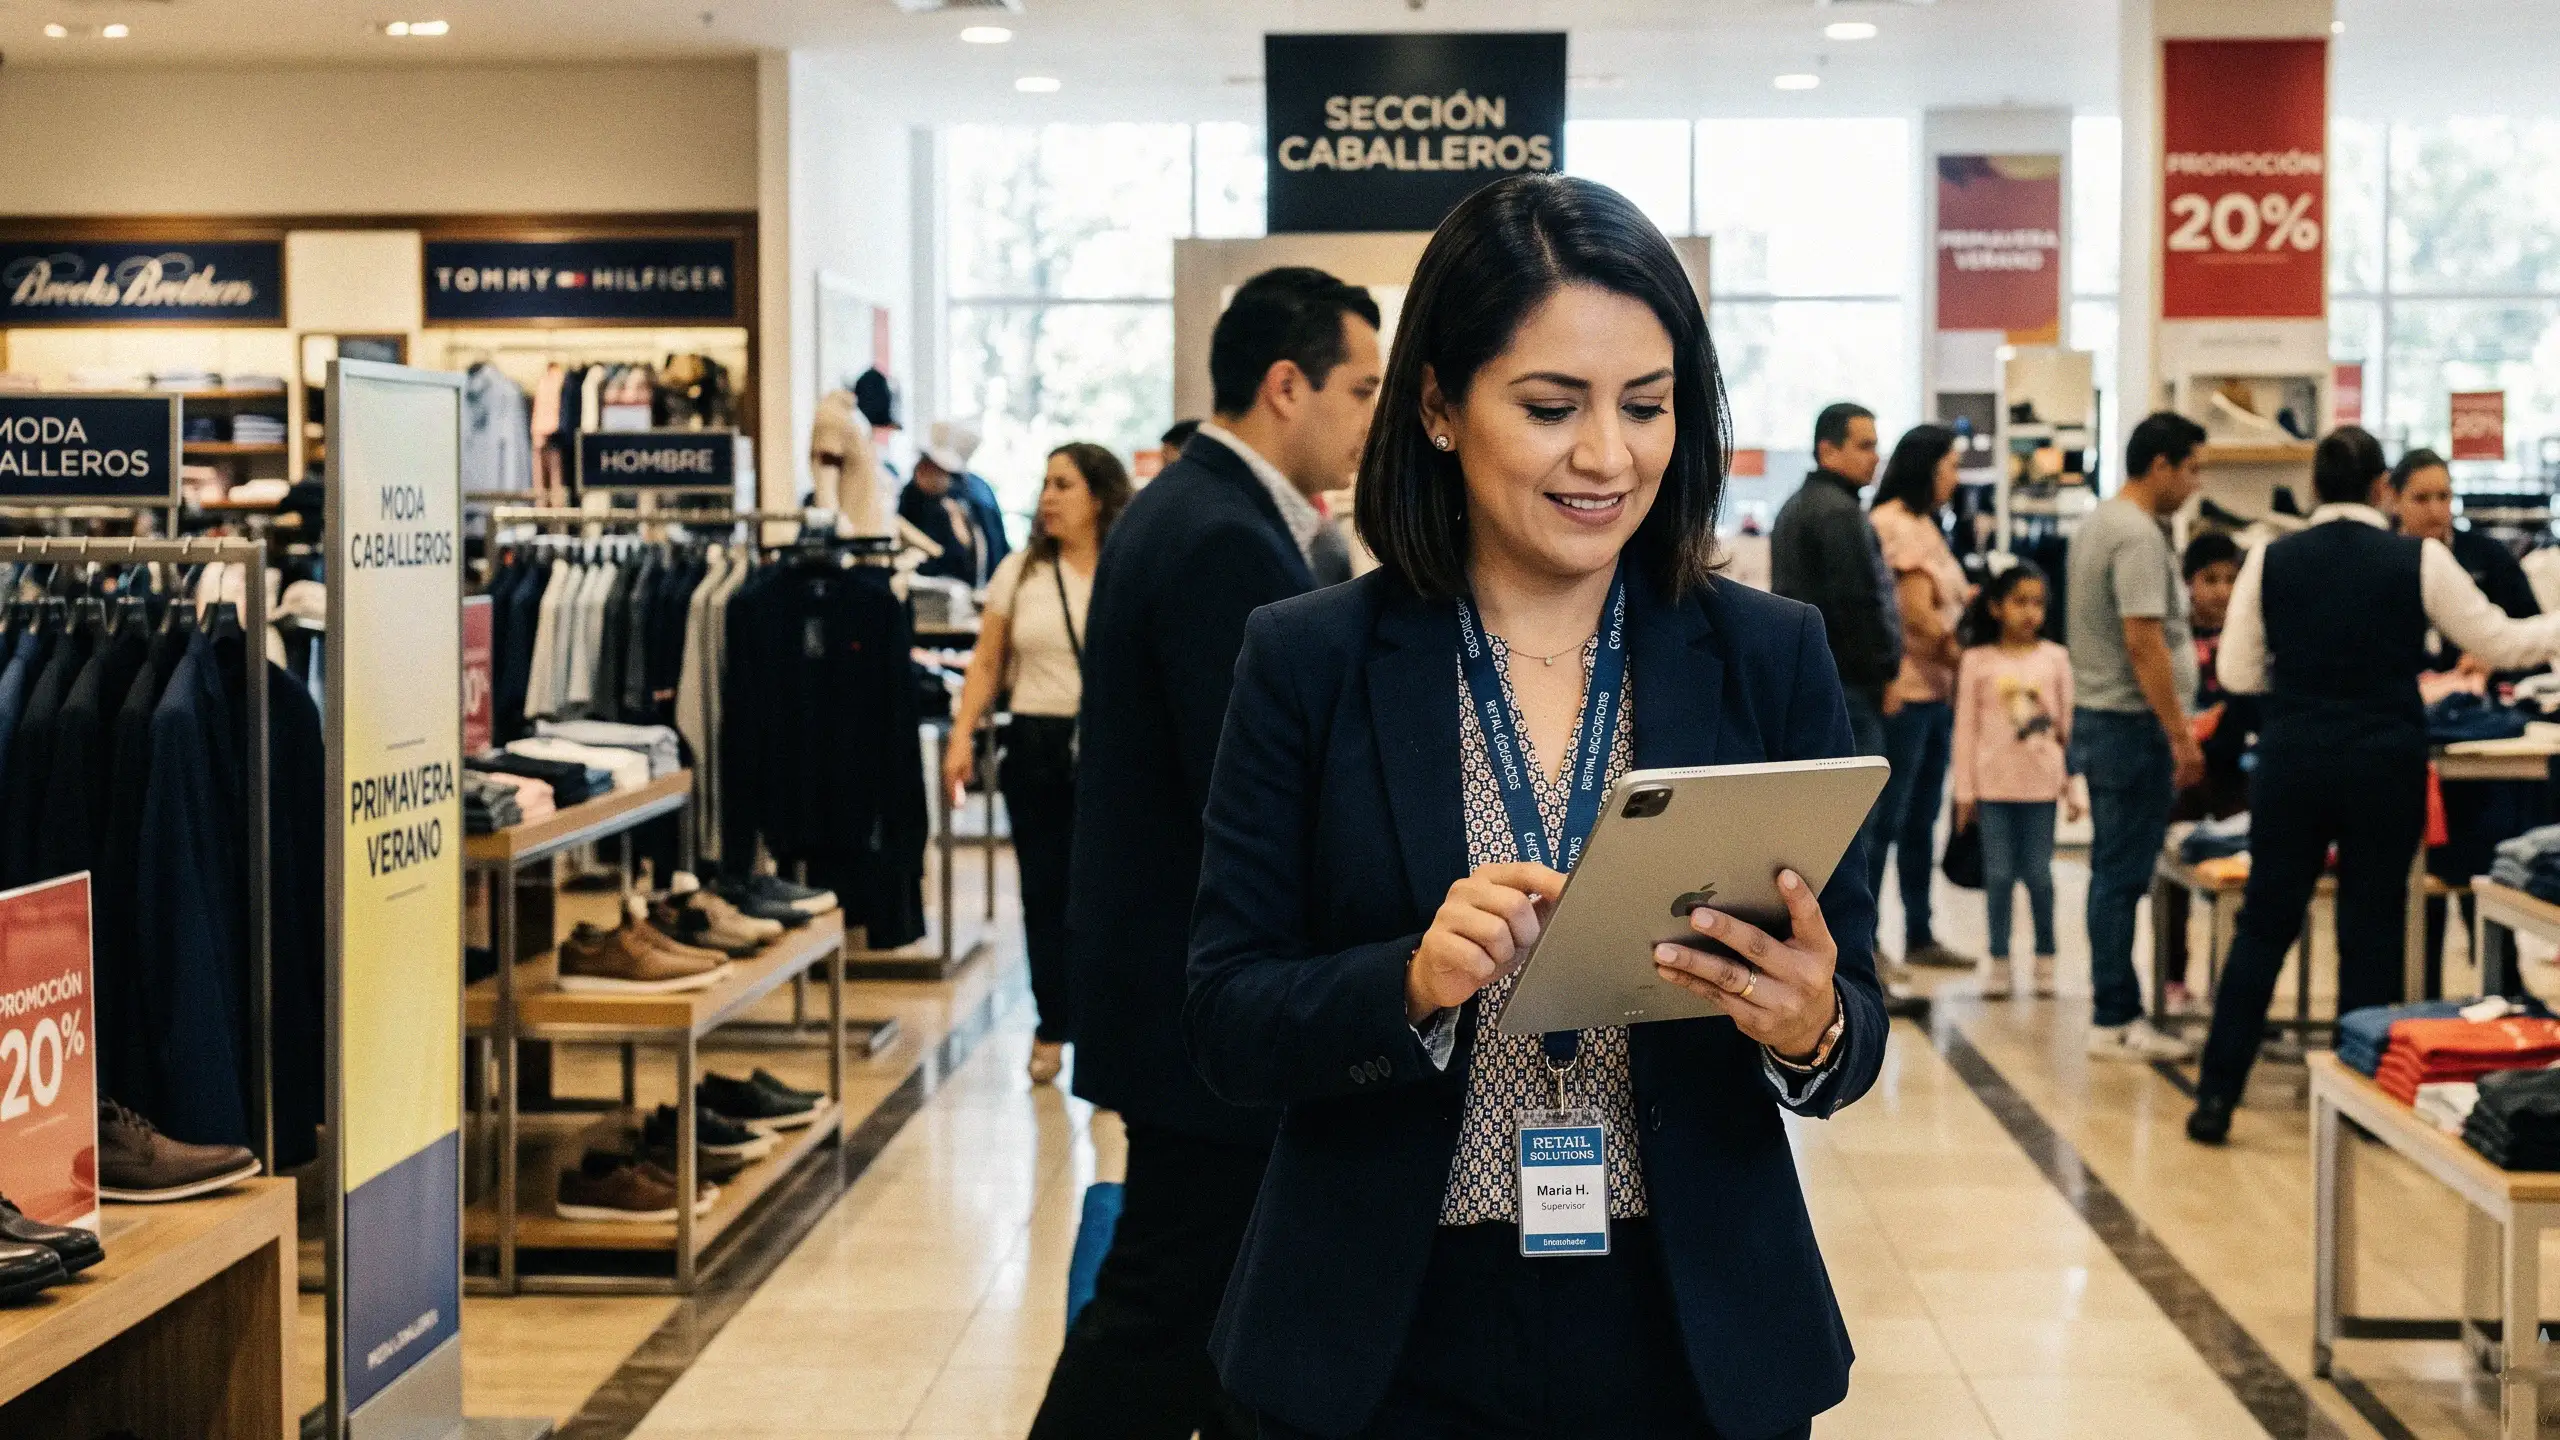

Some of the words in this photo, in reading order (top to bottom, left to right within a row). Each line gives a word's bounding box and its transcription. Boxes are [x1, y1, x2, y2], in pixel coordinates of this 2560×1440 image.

[1324, 88, 1506, 131] SECCIÓN
[1278, 133, 1553, 172] CABALLEROS
[2166, 148, 2323, 176] PROMOCIÓN
[2167, 191, 2321, 252] 20%
[435, 266, 552, 293] TOMMY
[592, 265, 725, 293] HILFIGER
[600, 448, 714, 474] HOMBRE
[380, 484, 425, 520] MODA
[351, 531, 453, 569] CABALLEROS
[351, 761, 454, 825] PRIMAVERA
[367, 818, 442, 879] VERANO
[0, 1007, 86, 1122] 20%
[1530, 1150, 1594, 1160] SOLUTIONS
[1533, 1136, 1590, 1148] RETAIL
[1537, 1184, 1571, 1196] Maria
[1576, 1184, 1589, 1195] H.
[1541, 1202, 1585, 1211] Supervisor
